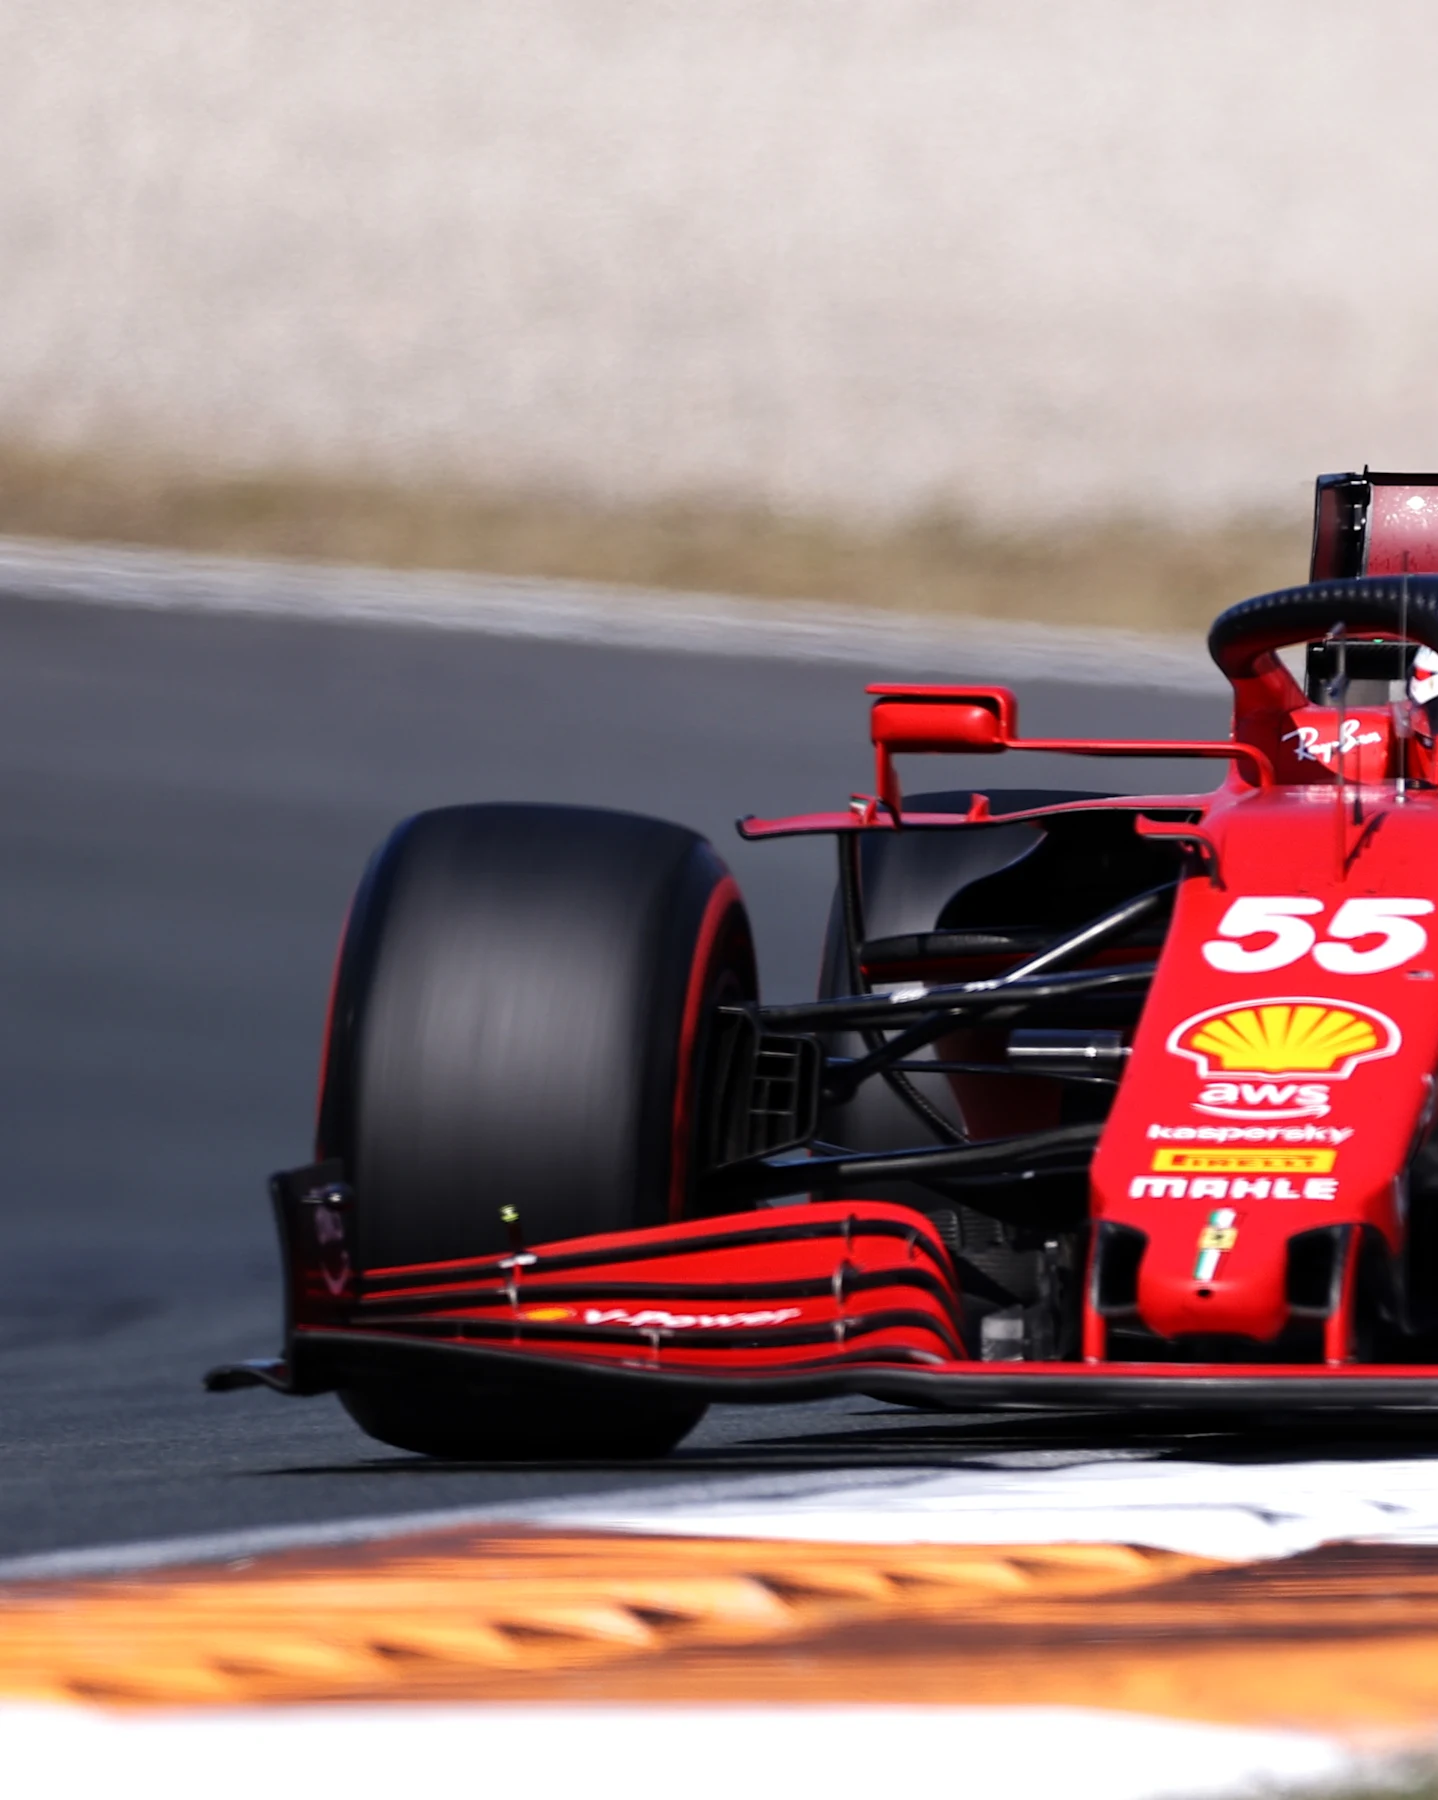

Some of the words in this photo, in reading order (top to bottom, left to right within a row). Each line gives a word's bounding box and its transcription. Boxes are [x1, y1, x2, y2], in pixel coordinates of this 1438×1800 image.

[1202, 896, 1435, 974] 55
[1200, 1083, 1330, 1105] aws
[1147, 1124, 1353, 1145] kaspersky
[1171, 1155, 1318, 1167] PIRELLI
[1130, 1176, 1339, 1200] MAHLE
[584, 1309, 801, 1328] V-Power
